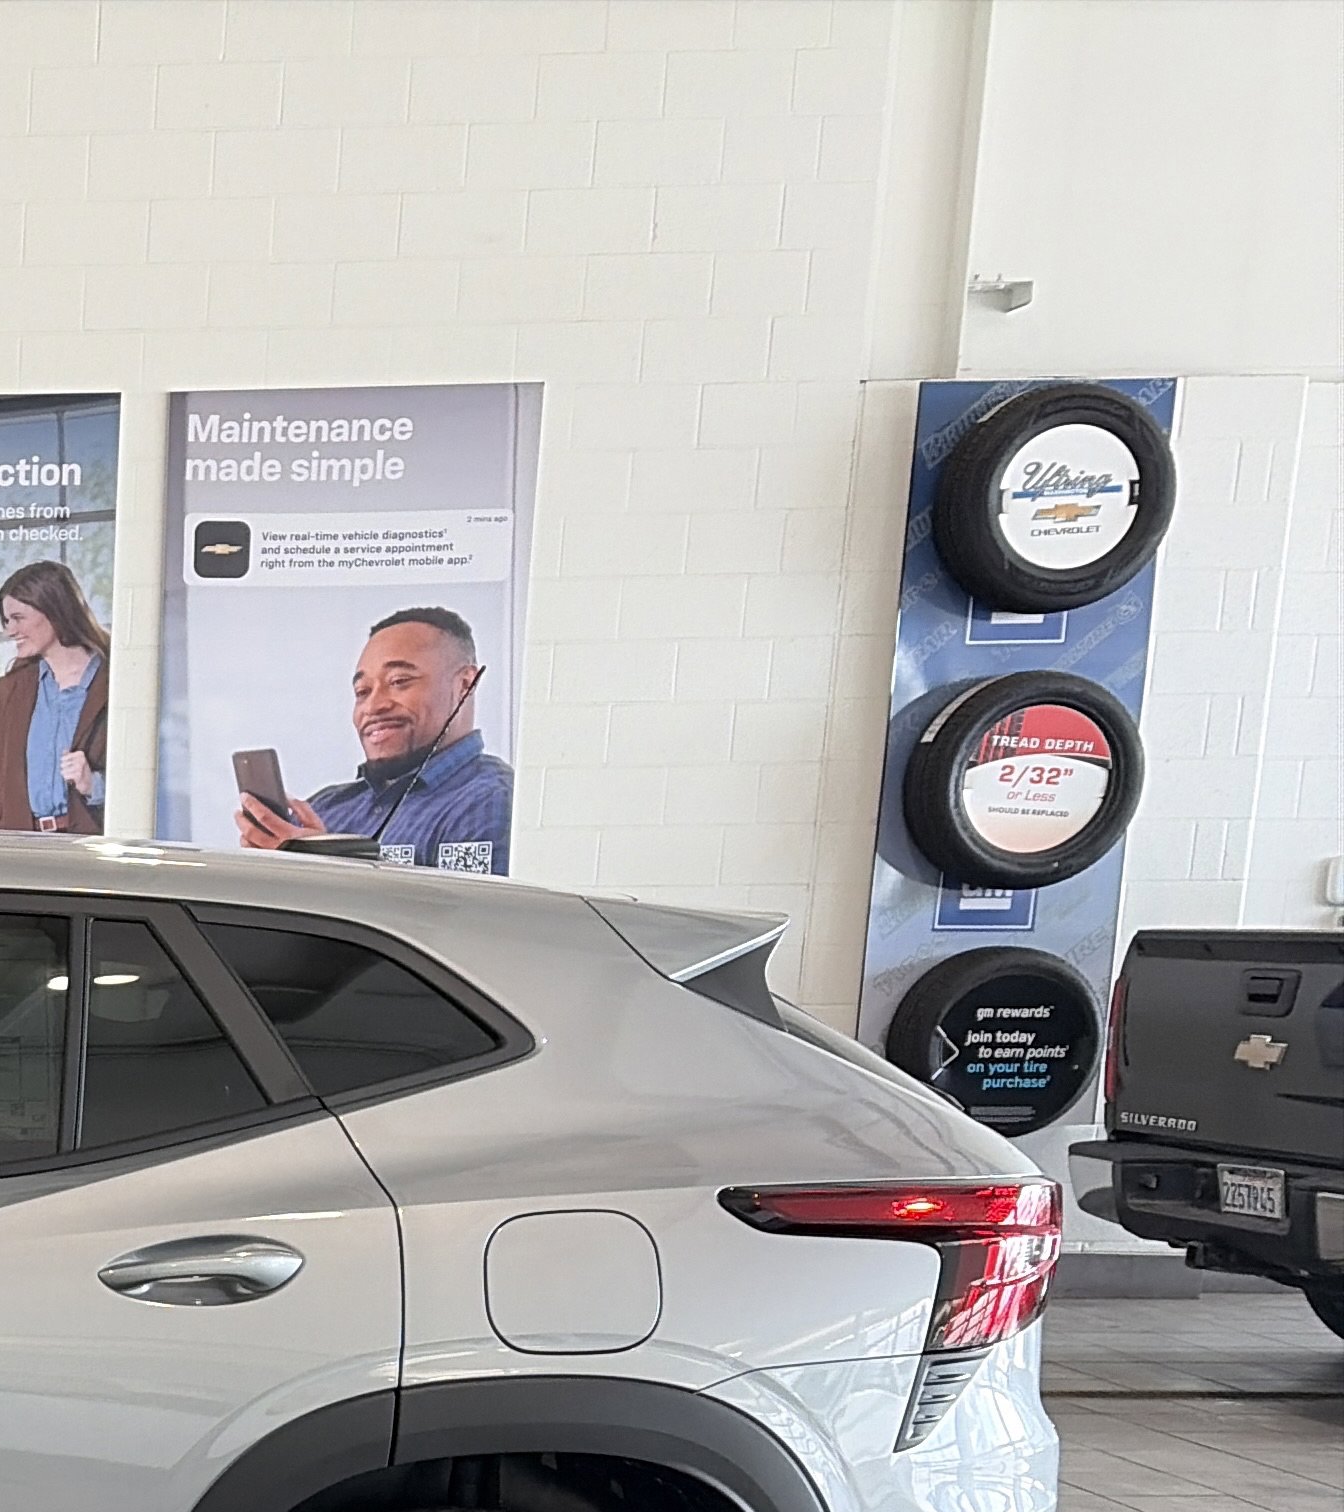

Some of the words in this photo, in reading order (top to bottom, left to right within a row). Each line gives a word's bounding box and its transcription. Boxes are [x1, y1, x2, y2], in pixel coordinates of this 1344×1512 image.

[187, 413, 413, 442] Maintenance
[185, 452, 281, 481] made
[290, 450, 404, 487] simple
[29, 503, 70, 518] from
[494, 516, 508, 524] ago
[9, 526, 83, 542] checked.
[262, 531, 286, 541] View
[290, 531, 338, 541] real-time
[342, 530, 378, 540] vehicle
[1031, 525, 1101, 537] CHEVROLET
[261, 545, 280, 555] and
[284, 544, 330, 555] schedule
[344, 546, 382, 554] service
[385, 542, 454, 555] appointment
[261, 558, 285, 570] right
[289, 558, 314, 568] from
[318, 558, 335, 568] the
[338, 556, 405, 570] myChevrolet
[408, 556, 444, 567] mobile
[992, 734, 1041, 748] TREAD
[1044, 738, 1094, 752] DEPTH
[1007, 789, 1022, 800] or
[1025, 789, 1056, 802] Less
[988, 806, 1019, 814] SHOULD
[977, 1009, 994, 1021] gm
[965, 1031, 992, 1045] join
[995, 1031, 1036, 1045] today
[978, 1046, 991, 1058] to
[994, 1048, 1024, 1058] earn
[967, 1063, 984, 1073] on
[989, 1063, 1020, 1075] your
[1023, 1062, 1047, 1073] tire
[1120, 1111, 1197, 1132] SILVERADO
